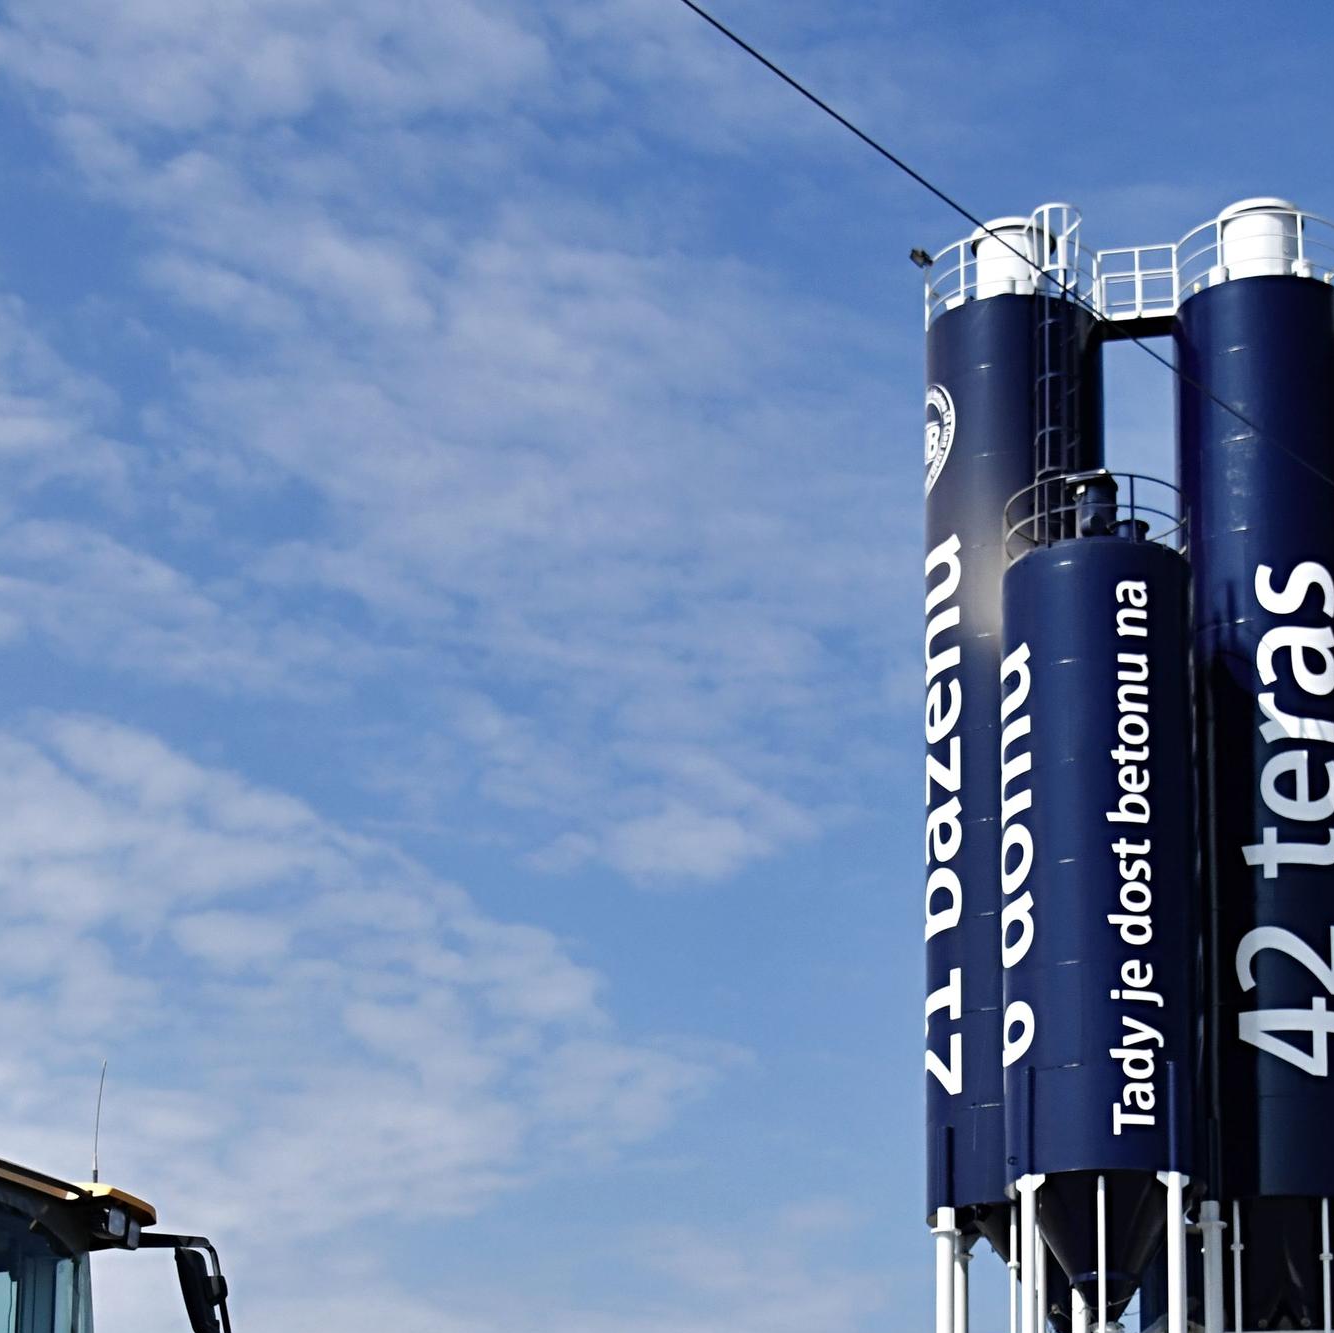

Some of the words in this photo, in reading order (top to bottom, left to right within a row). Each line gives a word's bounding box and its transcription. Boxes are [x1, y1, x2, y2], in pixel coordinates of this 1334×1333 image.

[1115, 580, 1149, 637] na
[1105, 653, 1151, 824] betonu
[1107, 837, 1153, 945] dost
[1110, 959, 1164, 1008] je
[1109, 1015, 1164, 1137] Tady
